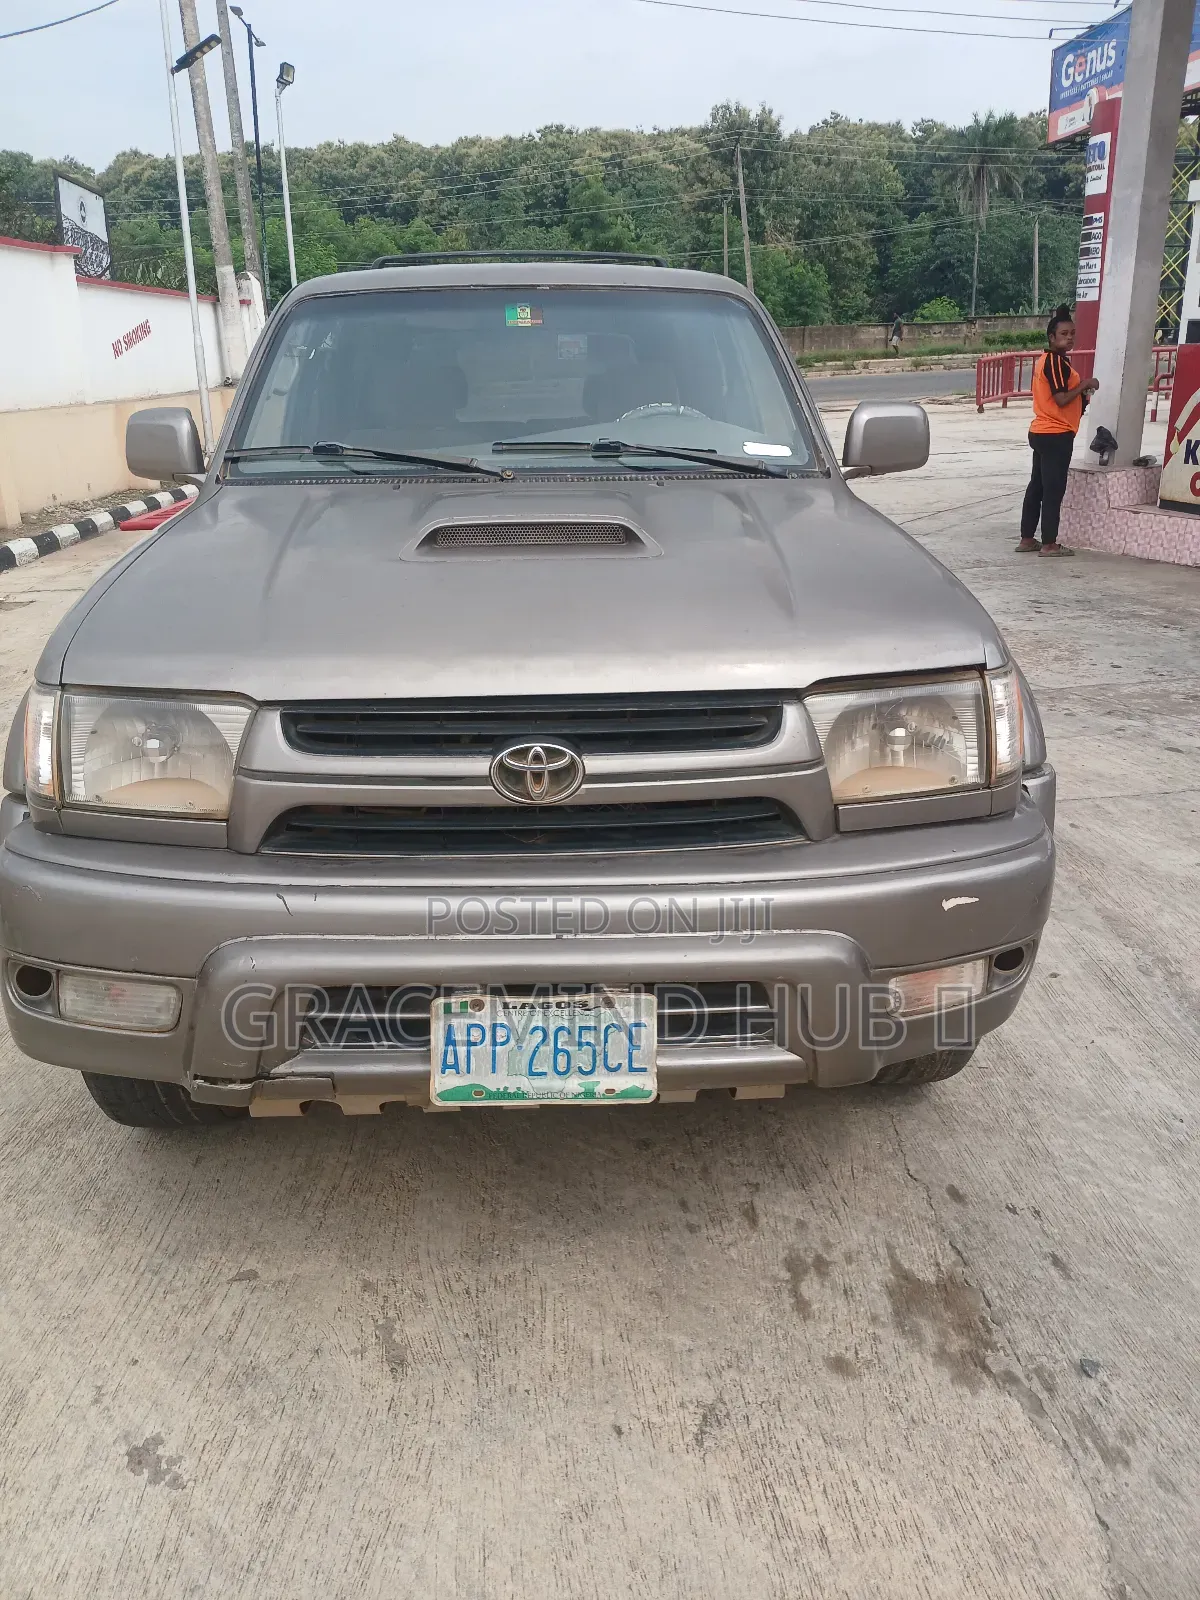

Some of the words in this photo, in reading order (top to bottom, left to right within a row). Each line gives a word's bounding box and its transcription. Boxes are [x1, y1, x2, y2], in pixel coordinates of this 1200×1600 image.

[1061, 39, 1117, 88] Genus
[111, 338, 124, 360] NO
[122, 318, 152, 352] SMOKING
[501, 1000, 590, 1011] LAGOS
[496, 1009, 526, 1017] CENTRE
[488, 1091, 521, 1099] FEDERAL
[523, 1091, 559, 1099] REPUBLIC
[571, 1091, 602, 1099] NIGERIA
